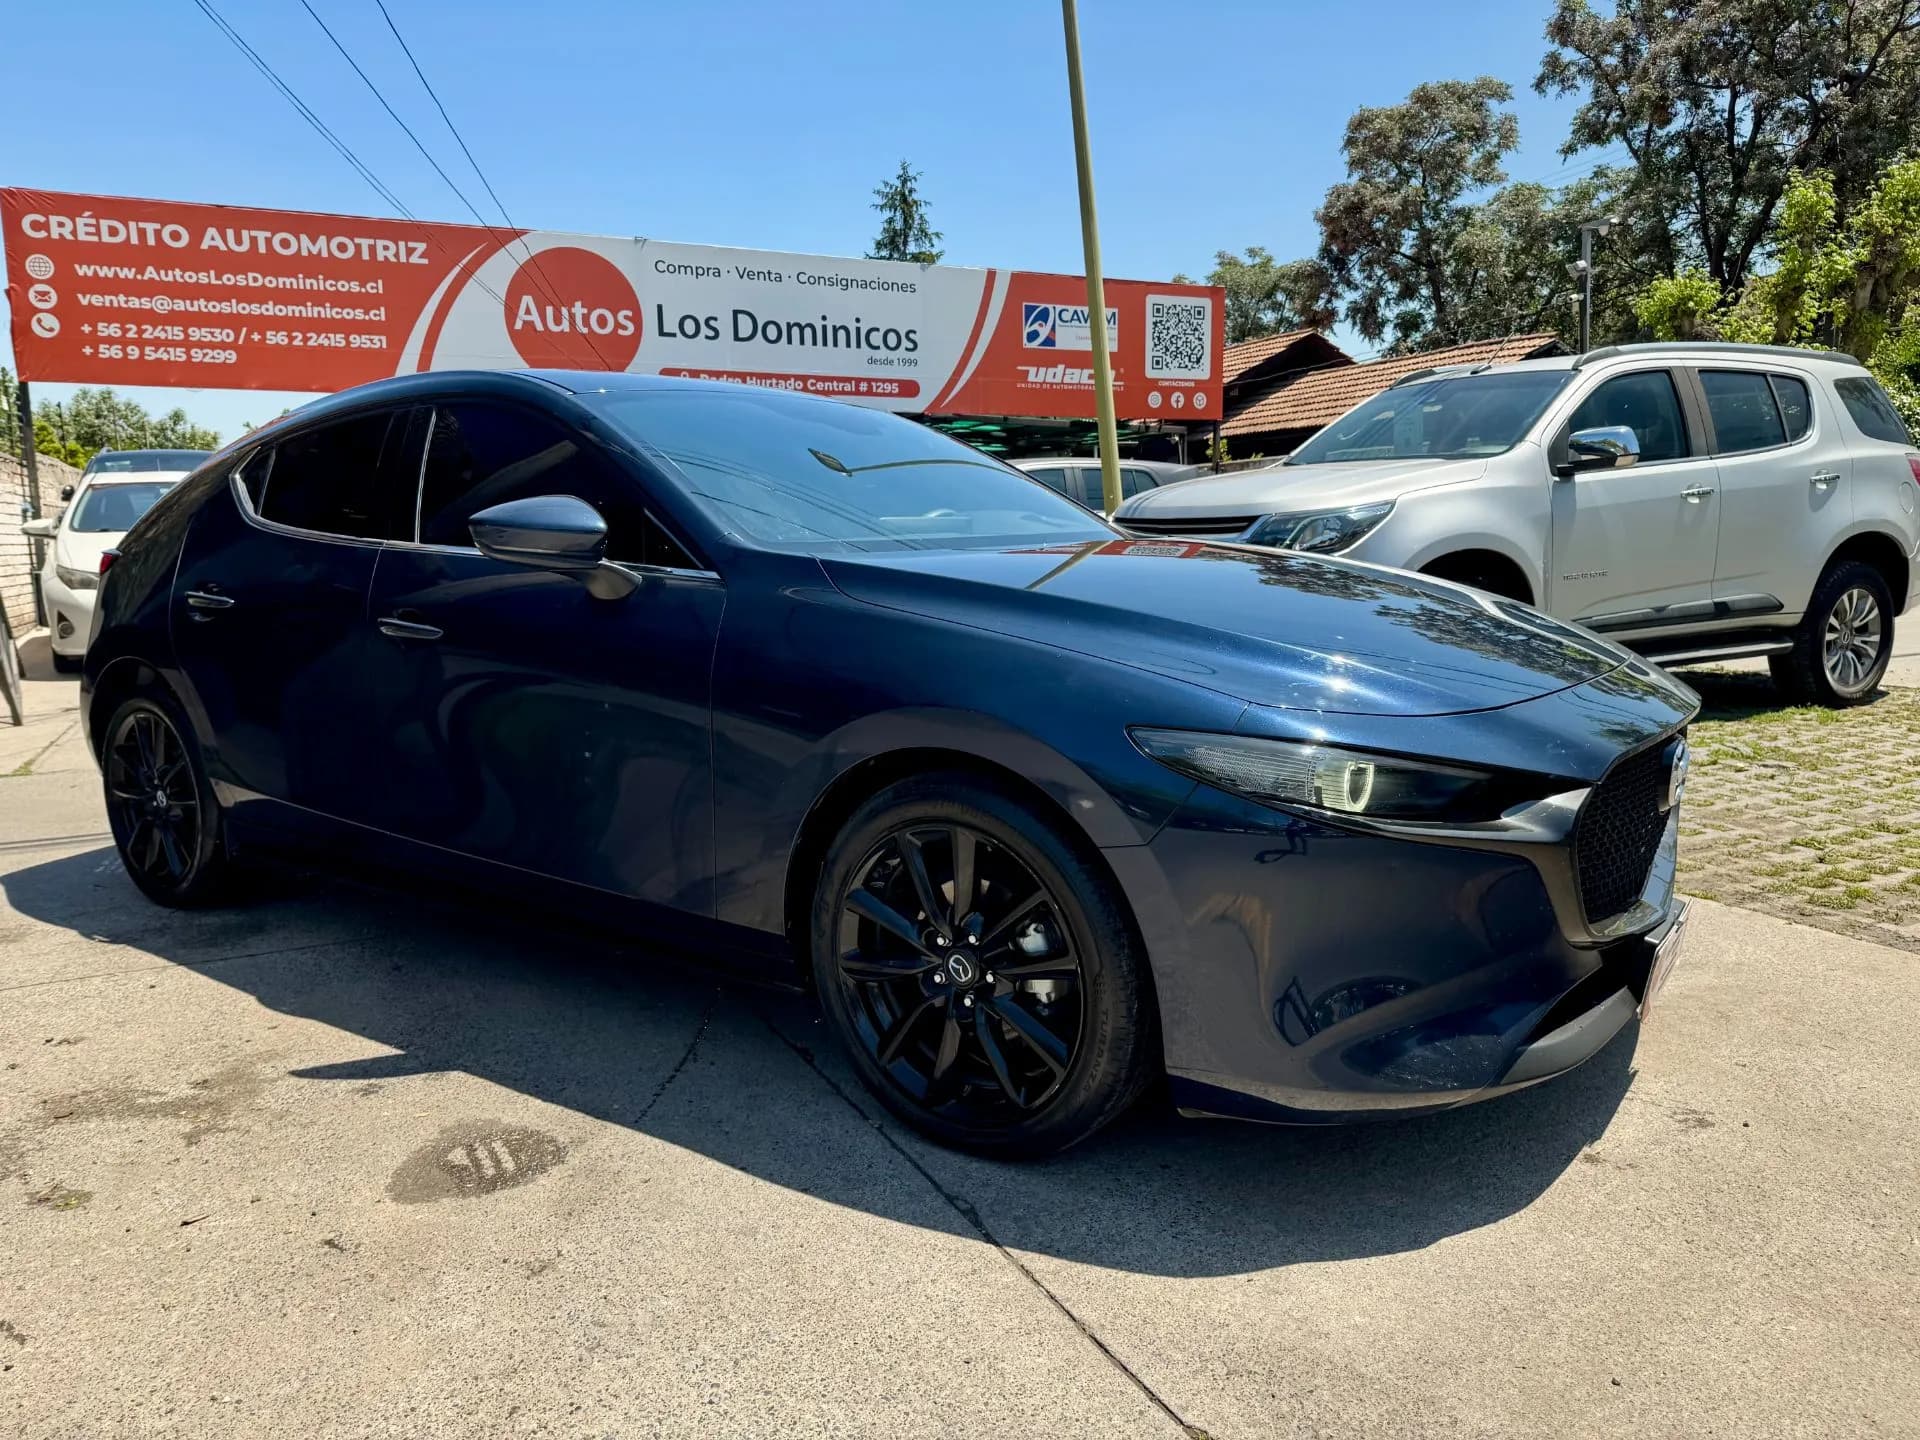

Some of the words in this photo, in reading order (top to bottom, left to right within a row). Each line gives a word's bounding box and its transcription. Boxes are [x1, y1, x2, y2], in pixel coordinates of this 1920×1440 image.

[21, 211, 190, 248] CRÉDITO
[200, 227, 429, 264] AUTOMOTRIZ
[74, 264, 384, 294] www.AutosLosDominicos.cl
[654, 260, 721, 279] Compra
[735, 266, 783, 283] Venta
[796, 272, 917, 293] Consignaciones
[76, 293, 386, 321] ventas@autoslosdominicos.cl
[514, 295, 635, 336] Autos
[1058, 308, 1117, 326] CAVM
[97, 322, 122, 337] 56
[125, 324, 138, 338] 2
[141, 325, 185, 340] 2415
[187, 327, 235, 343] 9530
[265, 331, 289, 345] 56
[292, 332, 304, 346] 2
[306, 333, 346, 348] 2415
[349, 334, 387, 349] 9531
[656, 304, 720, 341] Los
[732, 309, 918, 353] Dominicos
[98, 344, 123, 358] 56
[126, 345, 140, 360] 9
[144, 346, 187, 362] 5415
[190, 348, 237, 364] 9299
[867, 355, 895, 366] desde
[896, 357, 918, 367] 1999
[746, 376, 804, 391] Hurtado
[807, 379, 856, 393] Central
[859, 381, 869, 393] #
[871, 382, 899, 394] 1295
